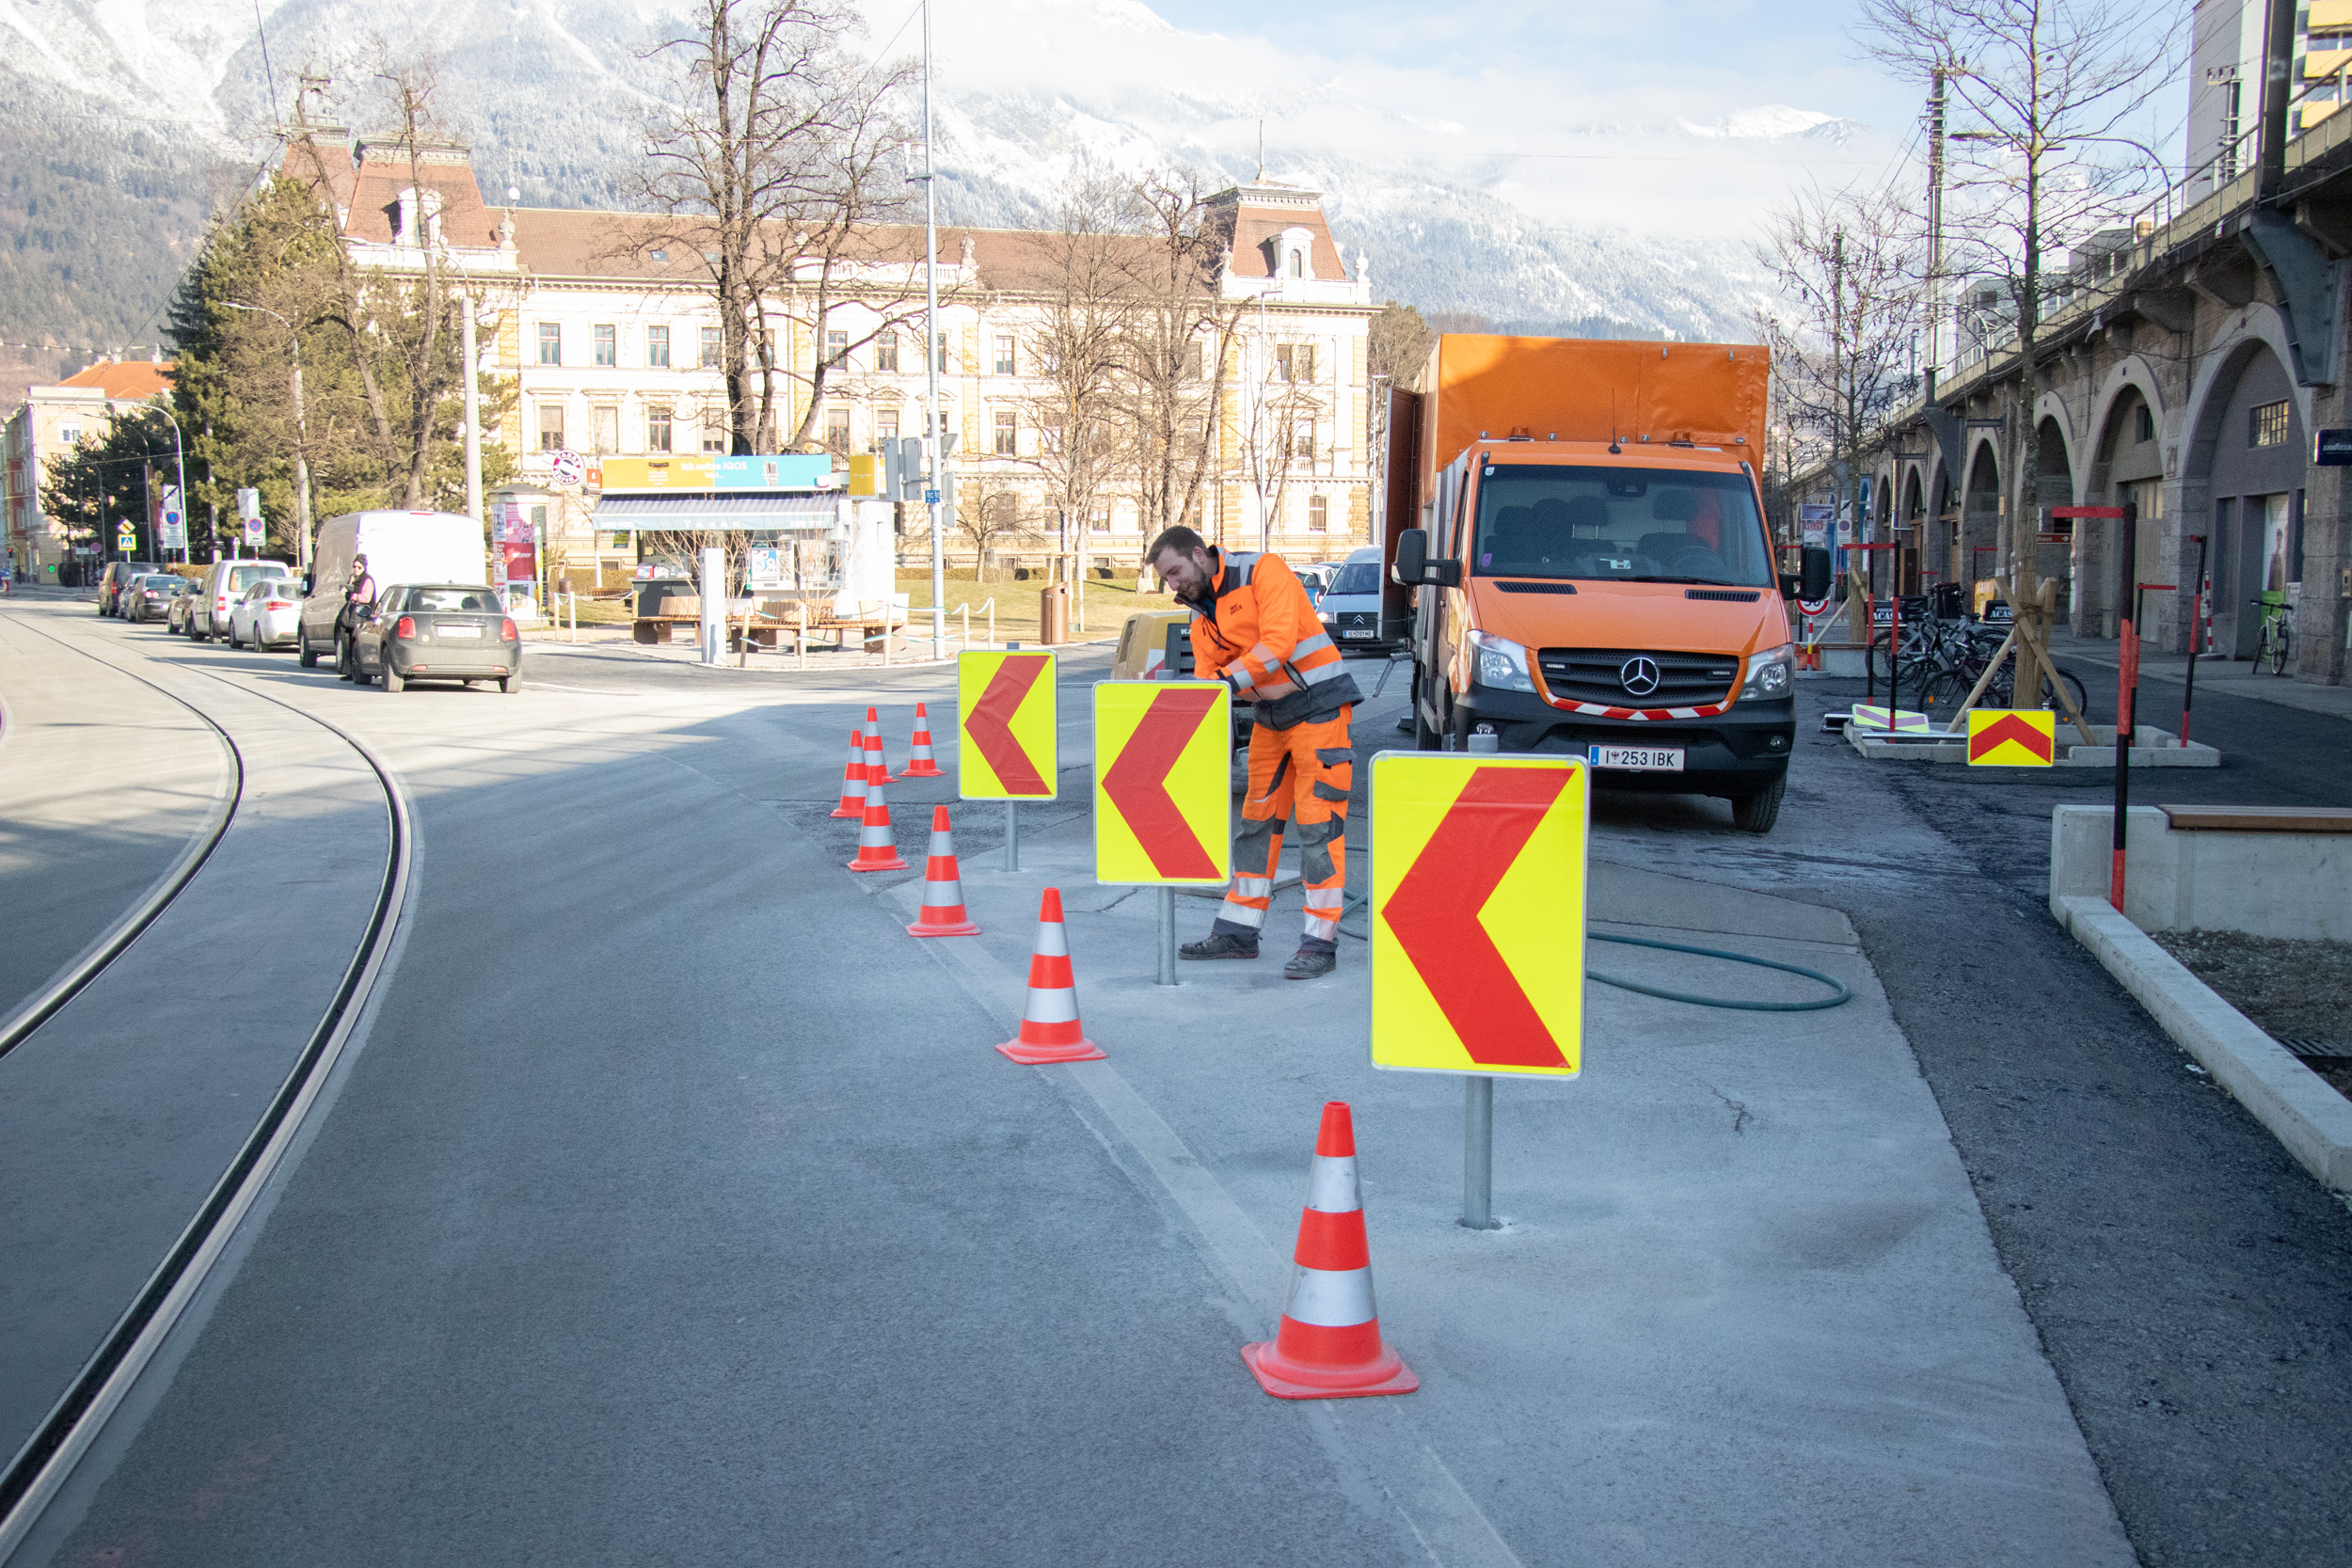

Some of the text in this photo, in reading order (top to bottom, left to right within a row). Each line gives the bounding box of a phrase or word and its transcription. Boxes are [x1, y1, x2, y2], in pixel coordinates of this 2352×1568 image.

[681, 462, 694, 470] Ich
[723, 461, 747, 470] IQOS
[1990, 610, 2014, 618] ACAS
[1621, 751, 1648, 766] 253
[1652, 752, 1675, 767] IBK
